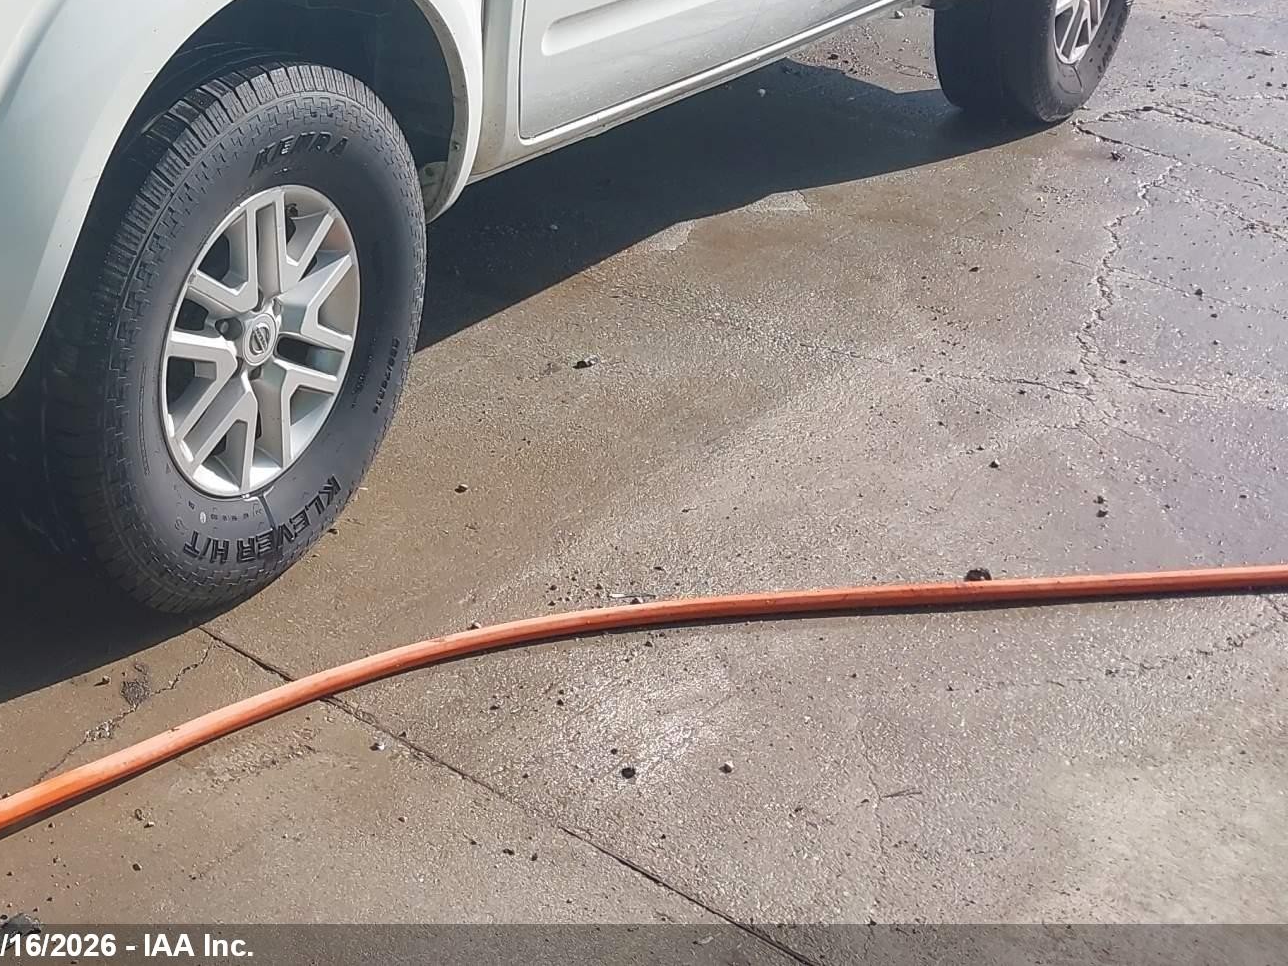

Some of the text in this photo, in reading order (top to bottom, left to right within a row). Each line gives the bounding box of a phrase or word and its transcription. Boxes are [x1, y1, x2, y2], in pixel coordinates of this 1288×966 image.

[249, 131, 349, 178] KENDA
[183, 474, 343, 564] KLEVER H/T
